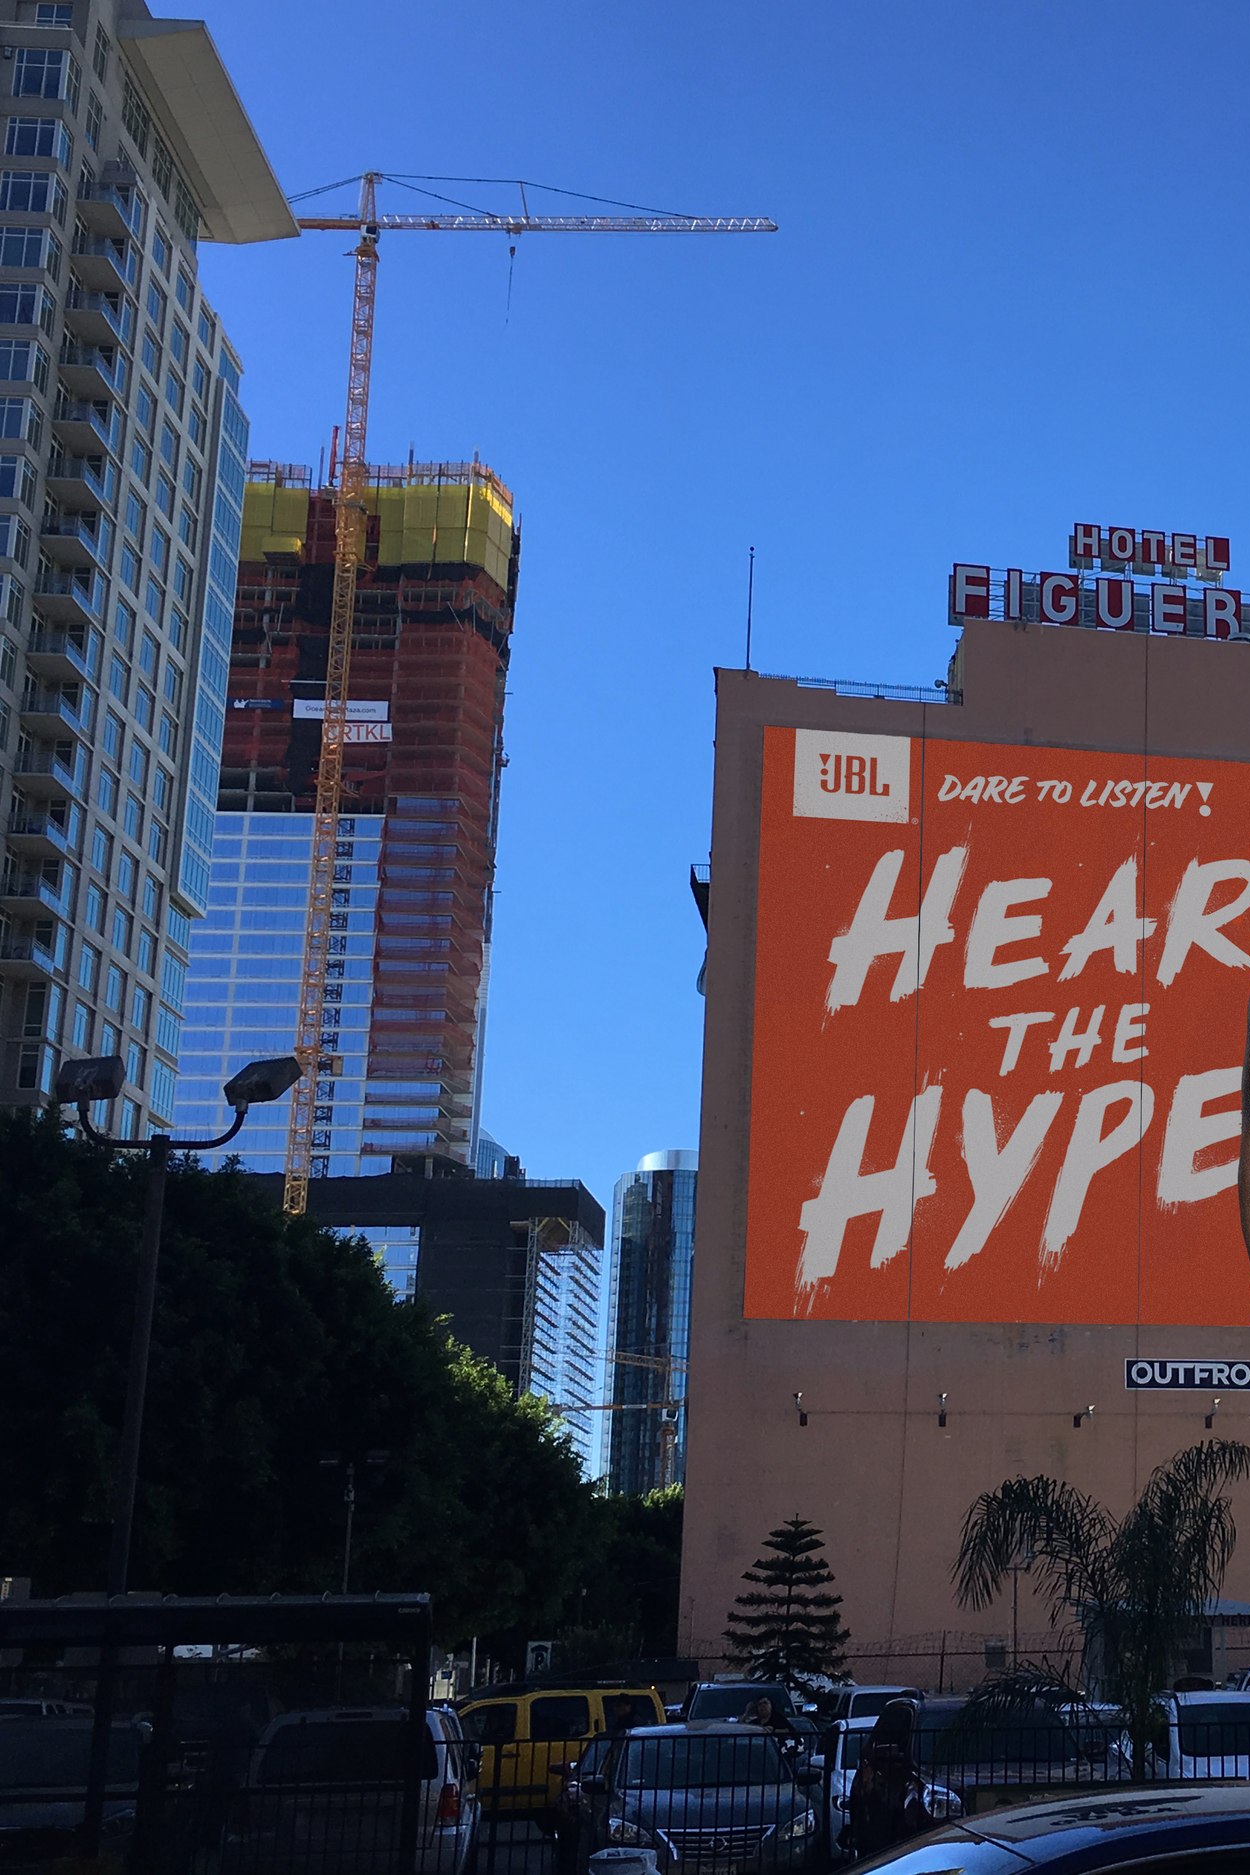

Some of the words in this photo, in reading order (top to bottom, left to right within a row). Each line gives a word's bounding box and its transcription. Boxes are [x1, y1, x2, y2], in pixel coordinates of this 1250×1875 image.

[1075, 523, 1229, 571] HOTEL
[818, 752, 890, 797] JBL
[937, 774, 1030, 805] DARE
[1036, 779, 1072, 803] TO
[988, 1002, 1151, 1077] THE
[795, 1066, 1243, 1296] HYPE
